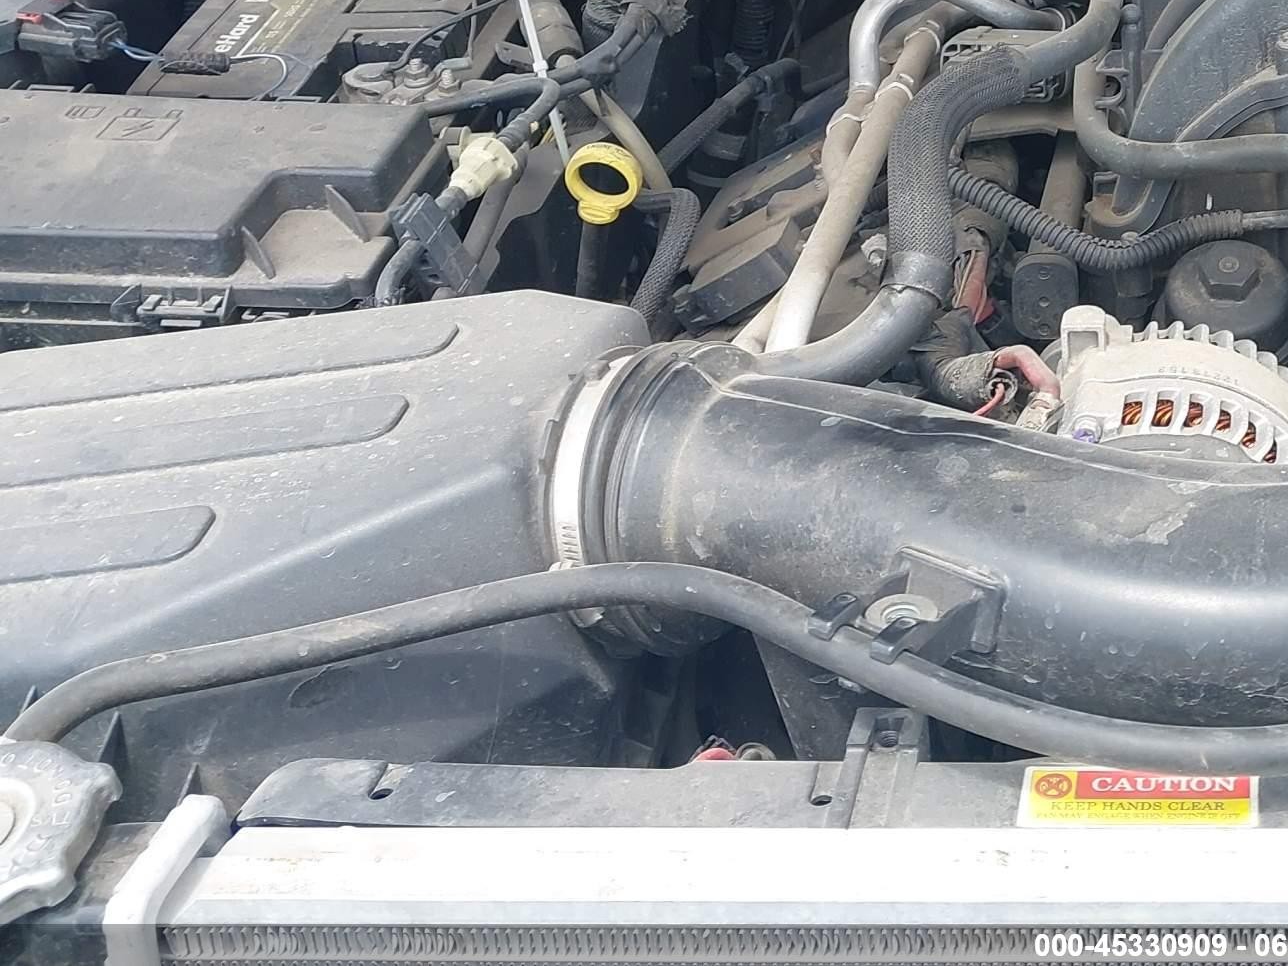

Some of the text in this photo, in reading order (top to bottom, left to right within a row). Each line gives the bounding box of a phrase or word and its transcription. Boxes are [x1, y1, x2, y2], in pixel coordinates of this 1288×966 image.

[1091, 777, 1237, 793] CAUTION
[1051, 801, 1225, 811] KEEP HANDS CLEAR
